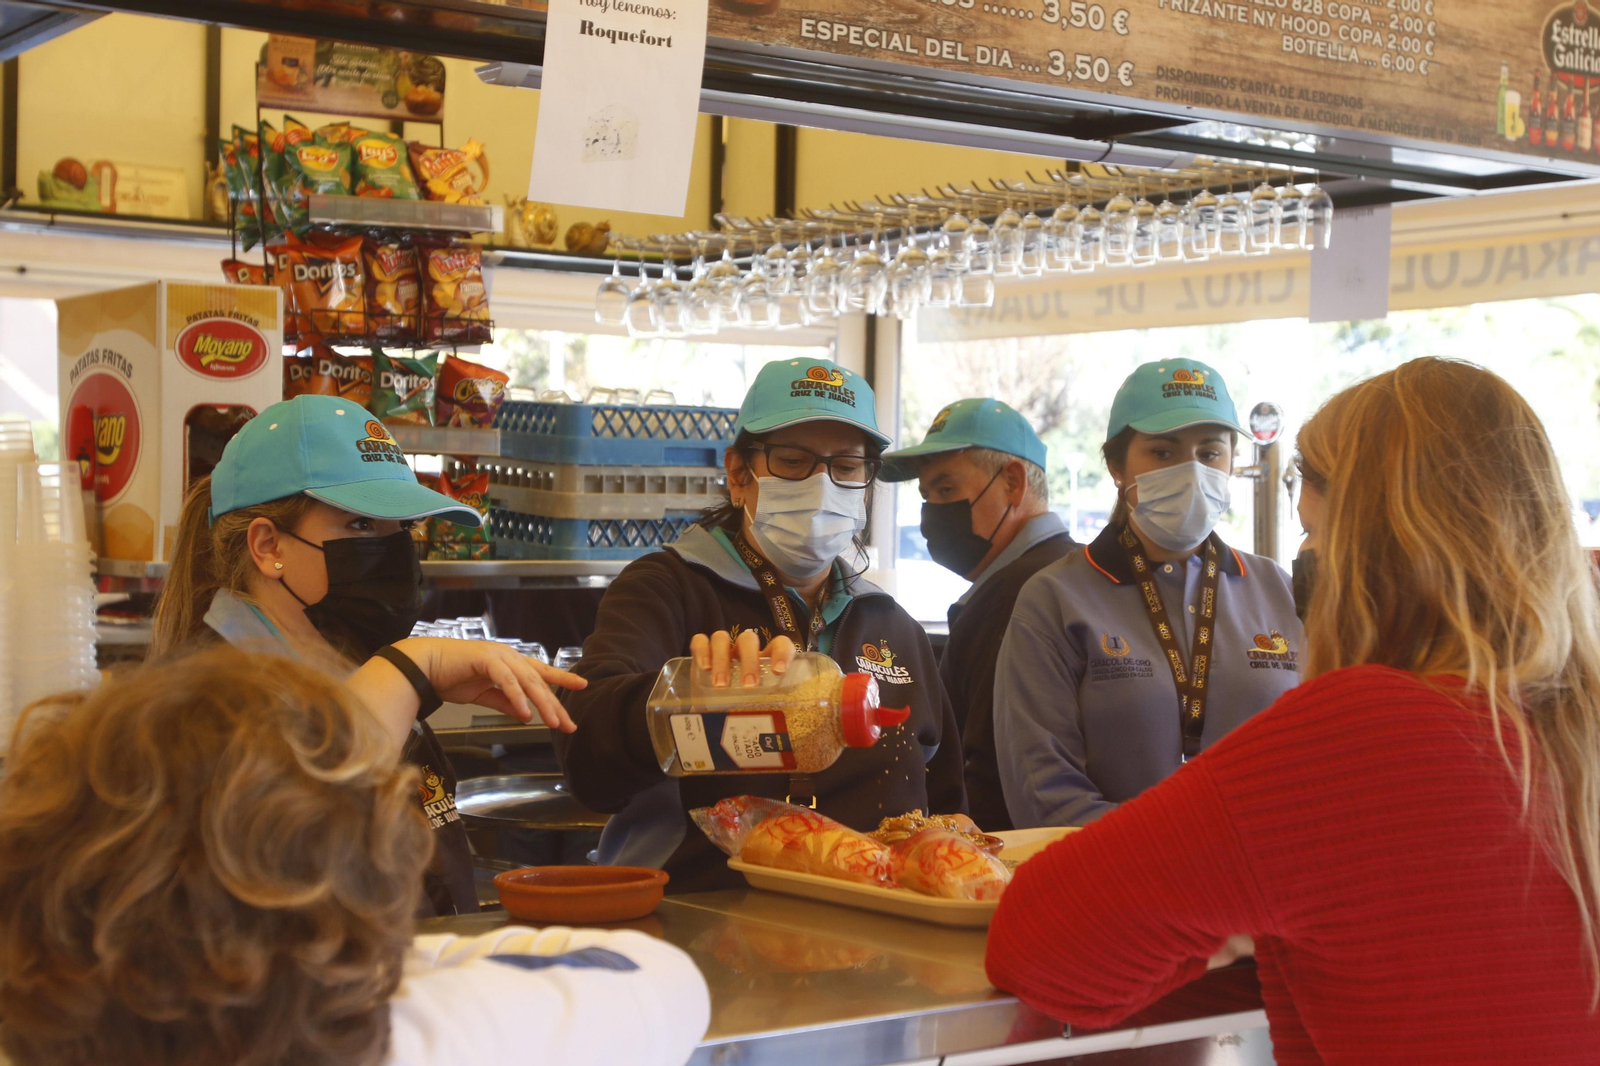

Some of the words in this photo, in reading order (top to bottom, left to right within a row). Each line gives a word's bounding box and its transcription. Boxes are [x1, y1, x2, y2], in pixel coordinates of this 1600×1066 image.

[1042, 0, 1105, 31] 3,50
[1113, 9, 1130, 35] €
[1254, 9, 1277, 28] NY
[1281, 14, 1331, 37] HOOD
[1338, 25, 1383, 47] COPA
[1388, 33, 1421, 54] 2,00
[1425, 40, 1435, 56] €
[1327, 1, 1372, 24] COPA
[1389, 13, 1423, 34] 2,00
[1427, 21, 1437, 37] €
[579, 19, 673, 48] Roquefort
[801, 17, 919, 54] ESPECIAL
[924, 37, 970, 62] DEL
[975, 44, 1014, 69] DIA
[1047, 49, 1110, 83] 3,50
[1117, 61, 1135, 87] €
[1282, 35, 1359, 64] BOTELLA
[1381, 52, 1415, 73] 6,00
[1419, 59, 1429, 75] €
[1157, 65, 1236, 90] DISPONEMOS
[1239, 79, 1276, 97] CARTA
[1279, 85, 1295, 99] DE
[1156, 84, 1223, 108] PROHIBIDO
[1226, 97, 1241, 110] LA
[1244, 99, 1282, 116] VENTA
[1285, 104, 1299, 119] DE
[1303, 107, 1356, 128] ALCOHOL
[1368, 118, 1420, 137] MENORES
[293, 262, 356, 282] Doritos
[186, 309, 225, 324] PATATAS
[228, 310, 259, 327] FRITAS
[192, 333, 254, 361] Moyano
[70, 348, 100, 385] PATATAS
[102, 348, 133, 379] FRITAS
[790, 389, 812, 397] CRUZ
[815, 390, 826, 398] DE
[828, 391, 856, 409] JUAREZ
[1091, 658, 1122, 668] CARACOL
[1123, 657, 1134, 666] DE
[1135, 659, 1151, 667] ORO
[1249, 661, 1270, 669] CRUZ
[886, 676, 915, 685] JUAREZ
